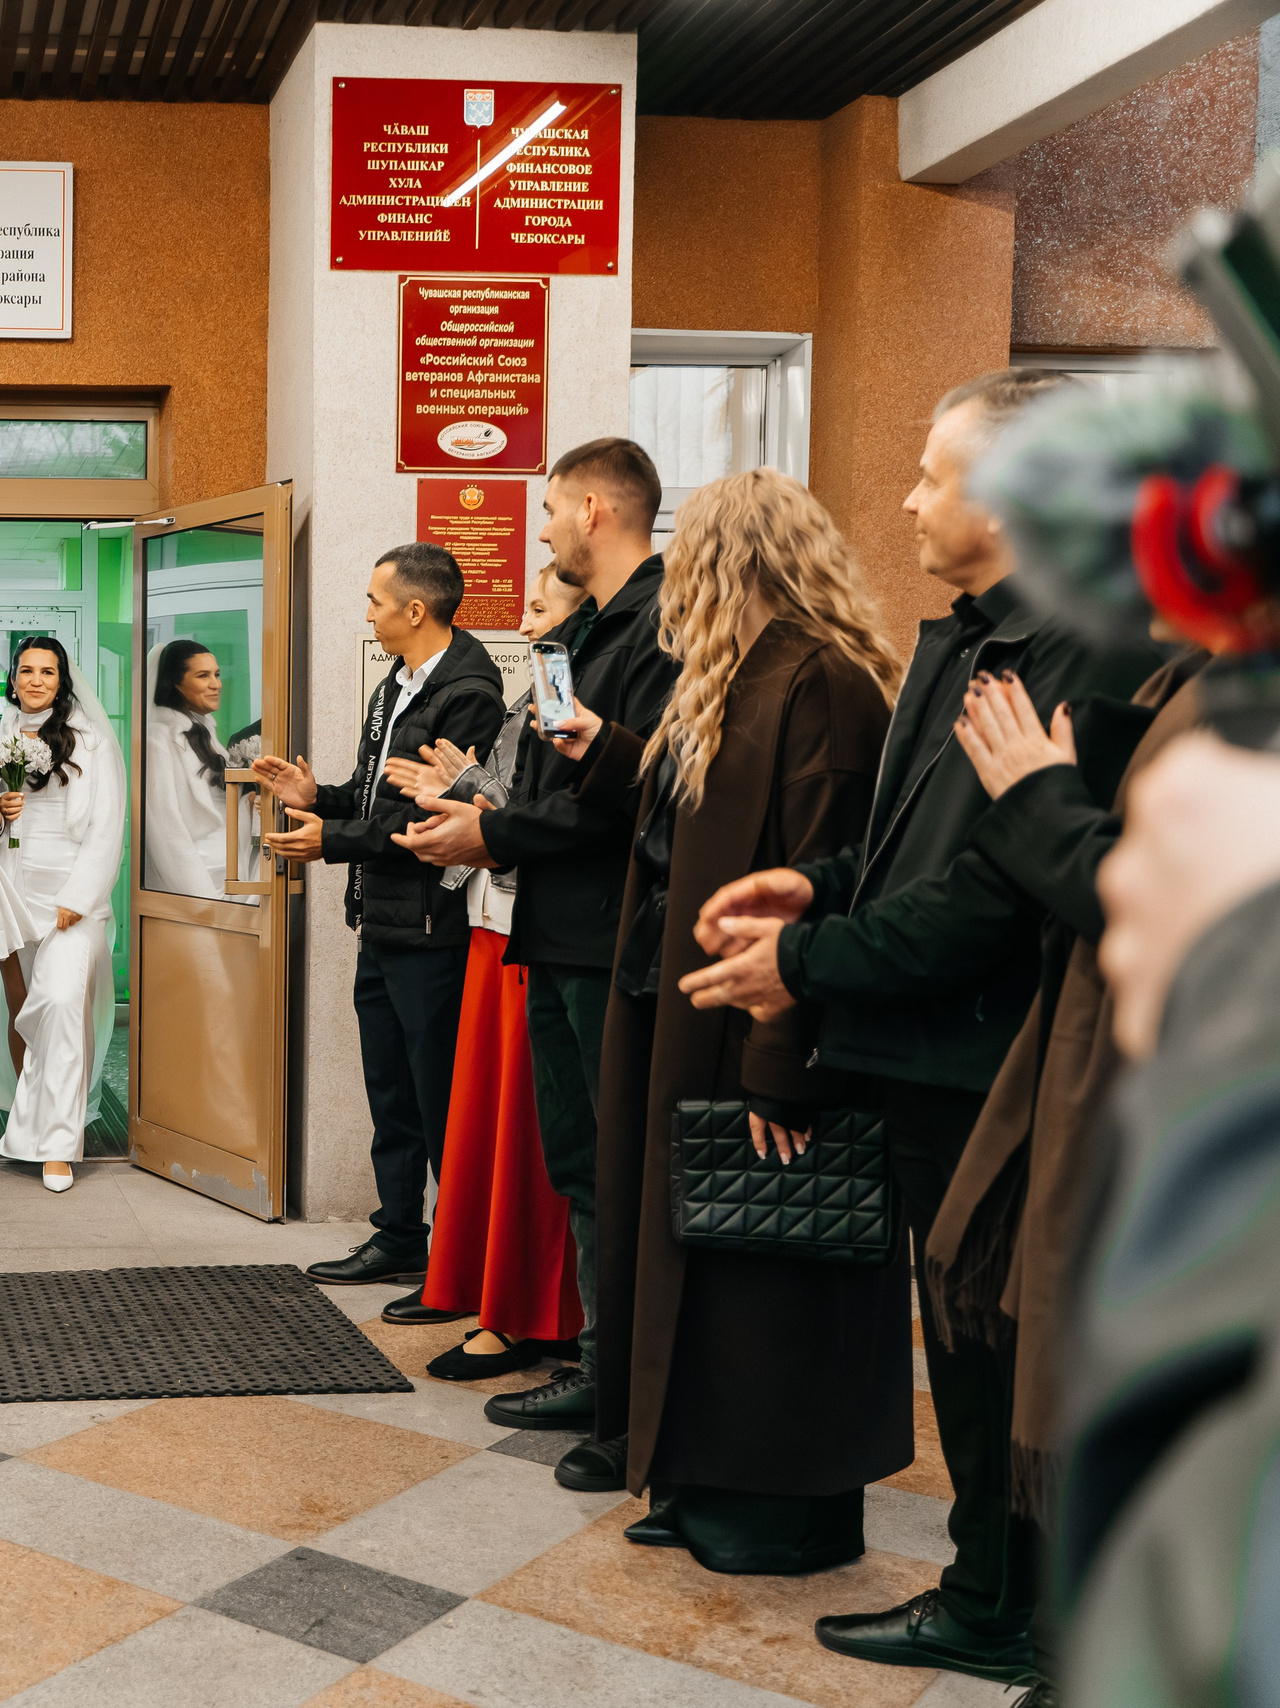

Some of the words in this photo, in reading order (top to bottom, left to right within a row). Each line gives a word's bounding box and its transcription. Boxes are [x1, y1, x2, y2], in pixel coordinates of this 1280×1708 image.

[511, 128, 589, 140] ЧАШСКАЯ
[363, 142, 449, 154] РЕСПУБЛИКИ
[515, 145, 590, 157] ЕСПУБЛИКА
[367, 160, 445, 171] ШУПАШКАР
[506, 163, 593, 175] ФИНАНСОВОЕ
[388, 177, 422, 188] ХУЛА
[509, 180, 589, 192] УПРАВЛЕНИЕ
[339, 195, 471, 208] АДМИНИСТРАЦИЕН
[493, 198, 604, 211] АДМИНИСТРАЦИИ
[377, 213, 433, 224] ФИНАНС
[524, 215, 572, 228] ГОРОДА
[511, 233, 586, 245] ЧЕБОКСАРЫ
[1, 269, 46, 285] района
[419, 287, 461, 300] Чувашская
[462, 288, 530, 301] республиканская
[449, 304, 499, 316] организация
[440, 320, 515, 334] Общероссийской
[415, 335, 477, 347] общественной
[479, 336, 535, 349] организации
[420, 353, 494, 367] «Российский
[497, 354, 527, 367] Союз
[405, 371, 463, 384] ветеранов
[467, 370, 541, 384] Афганистана
[430, 388, 437, 398] и
[440, 388, 516, 400] специальных
[416, 404, 465, 415] военных
[467, 403, 529, 417] операций»
[370, 704, 384, 741] CALVIN
[365, 755, 376, 783] KLEIN
[353, 864, 362, 900] CALVIN
